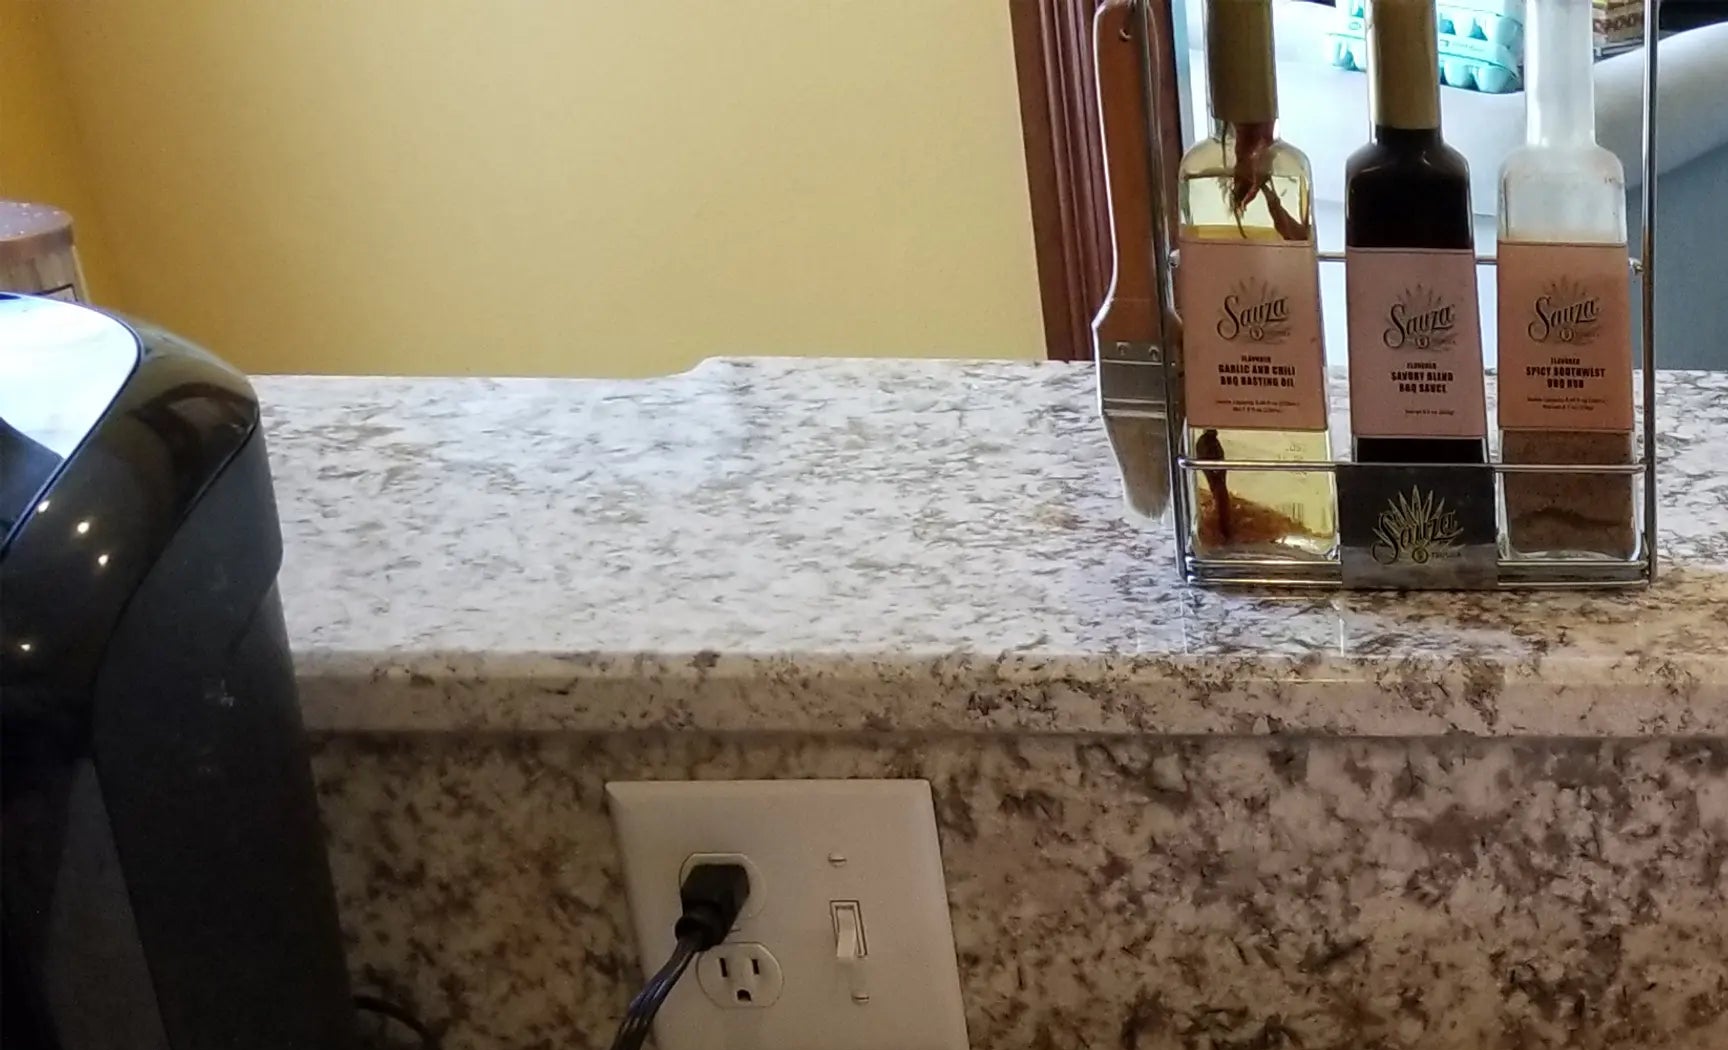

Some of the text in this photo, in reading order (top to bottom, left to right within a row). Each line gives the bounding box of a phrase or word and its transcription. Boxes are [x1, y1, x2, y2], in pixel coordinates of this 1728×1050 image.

[1217, 295, 1288, 341] Sauza
[1528, 296, 1599, 342] Sauza
[1383, 303, 1455, 349] Sauza
[1218, 364, 1296, 376] GARLIC AND CHILI
[1526, 366, 1606, 378] SPICY SOUTHWEST
[1240, 376, 1279, 387] BASTING
[1280, 377, 1296, 388] OIL
[1391, 371, 1454, 382] SAVORY BLEND
[1399, 383, 1448, 394] BBQ SAUCE
[1371, 509, 1459, 565] Sauza
